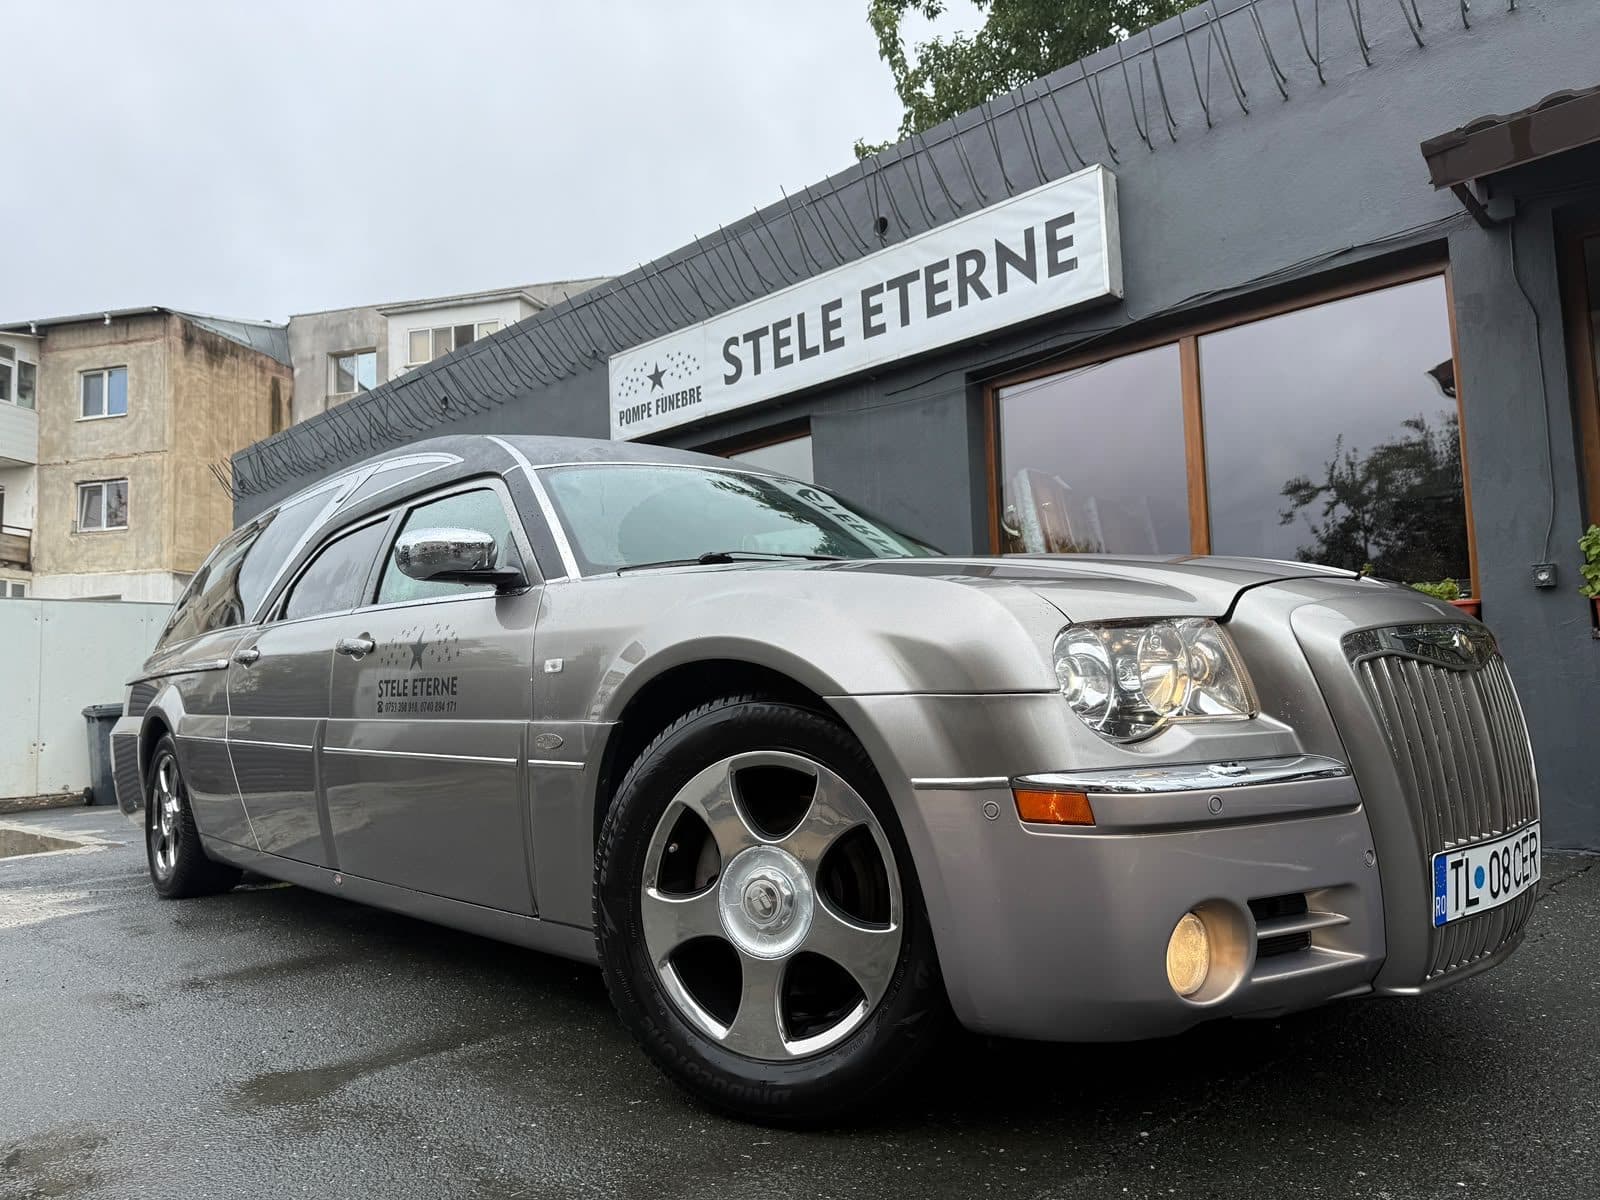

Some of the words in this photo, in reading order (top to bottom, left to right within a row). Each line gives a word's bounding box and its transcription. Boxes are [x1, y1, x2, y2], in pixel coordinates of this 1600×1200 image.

[723, 297, 845, 386] STELE
[860, 211, 1078, 340] ETERNE
[619, 401, 653, 427] POMPE
[655, 385, 703, 416] FUNEBRE
[377, 679, 409, 698] STELE
[412, 676, 458, 697] ETERNE
[1449, 857, 1480, 912] TL
[1435, 895, 1446, 917] RO
